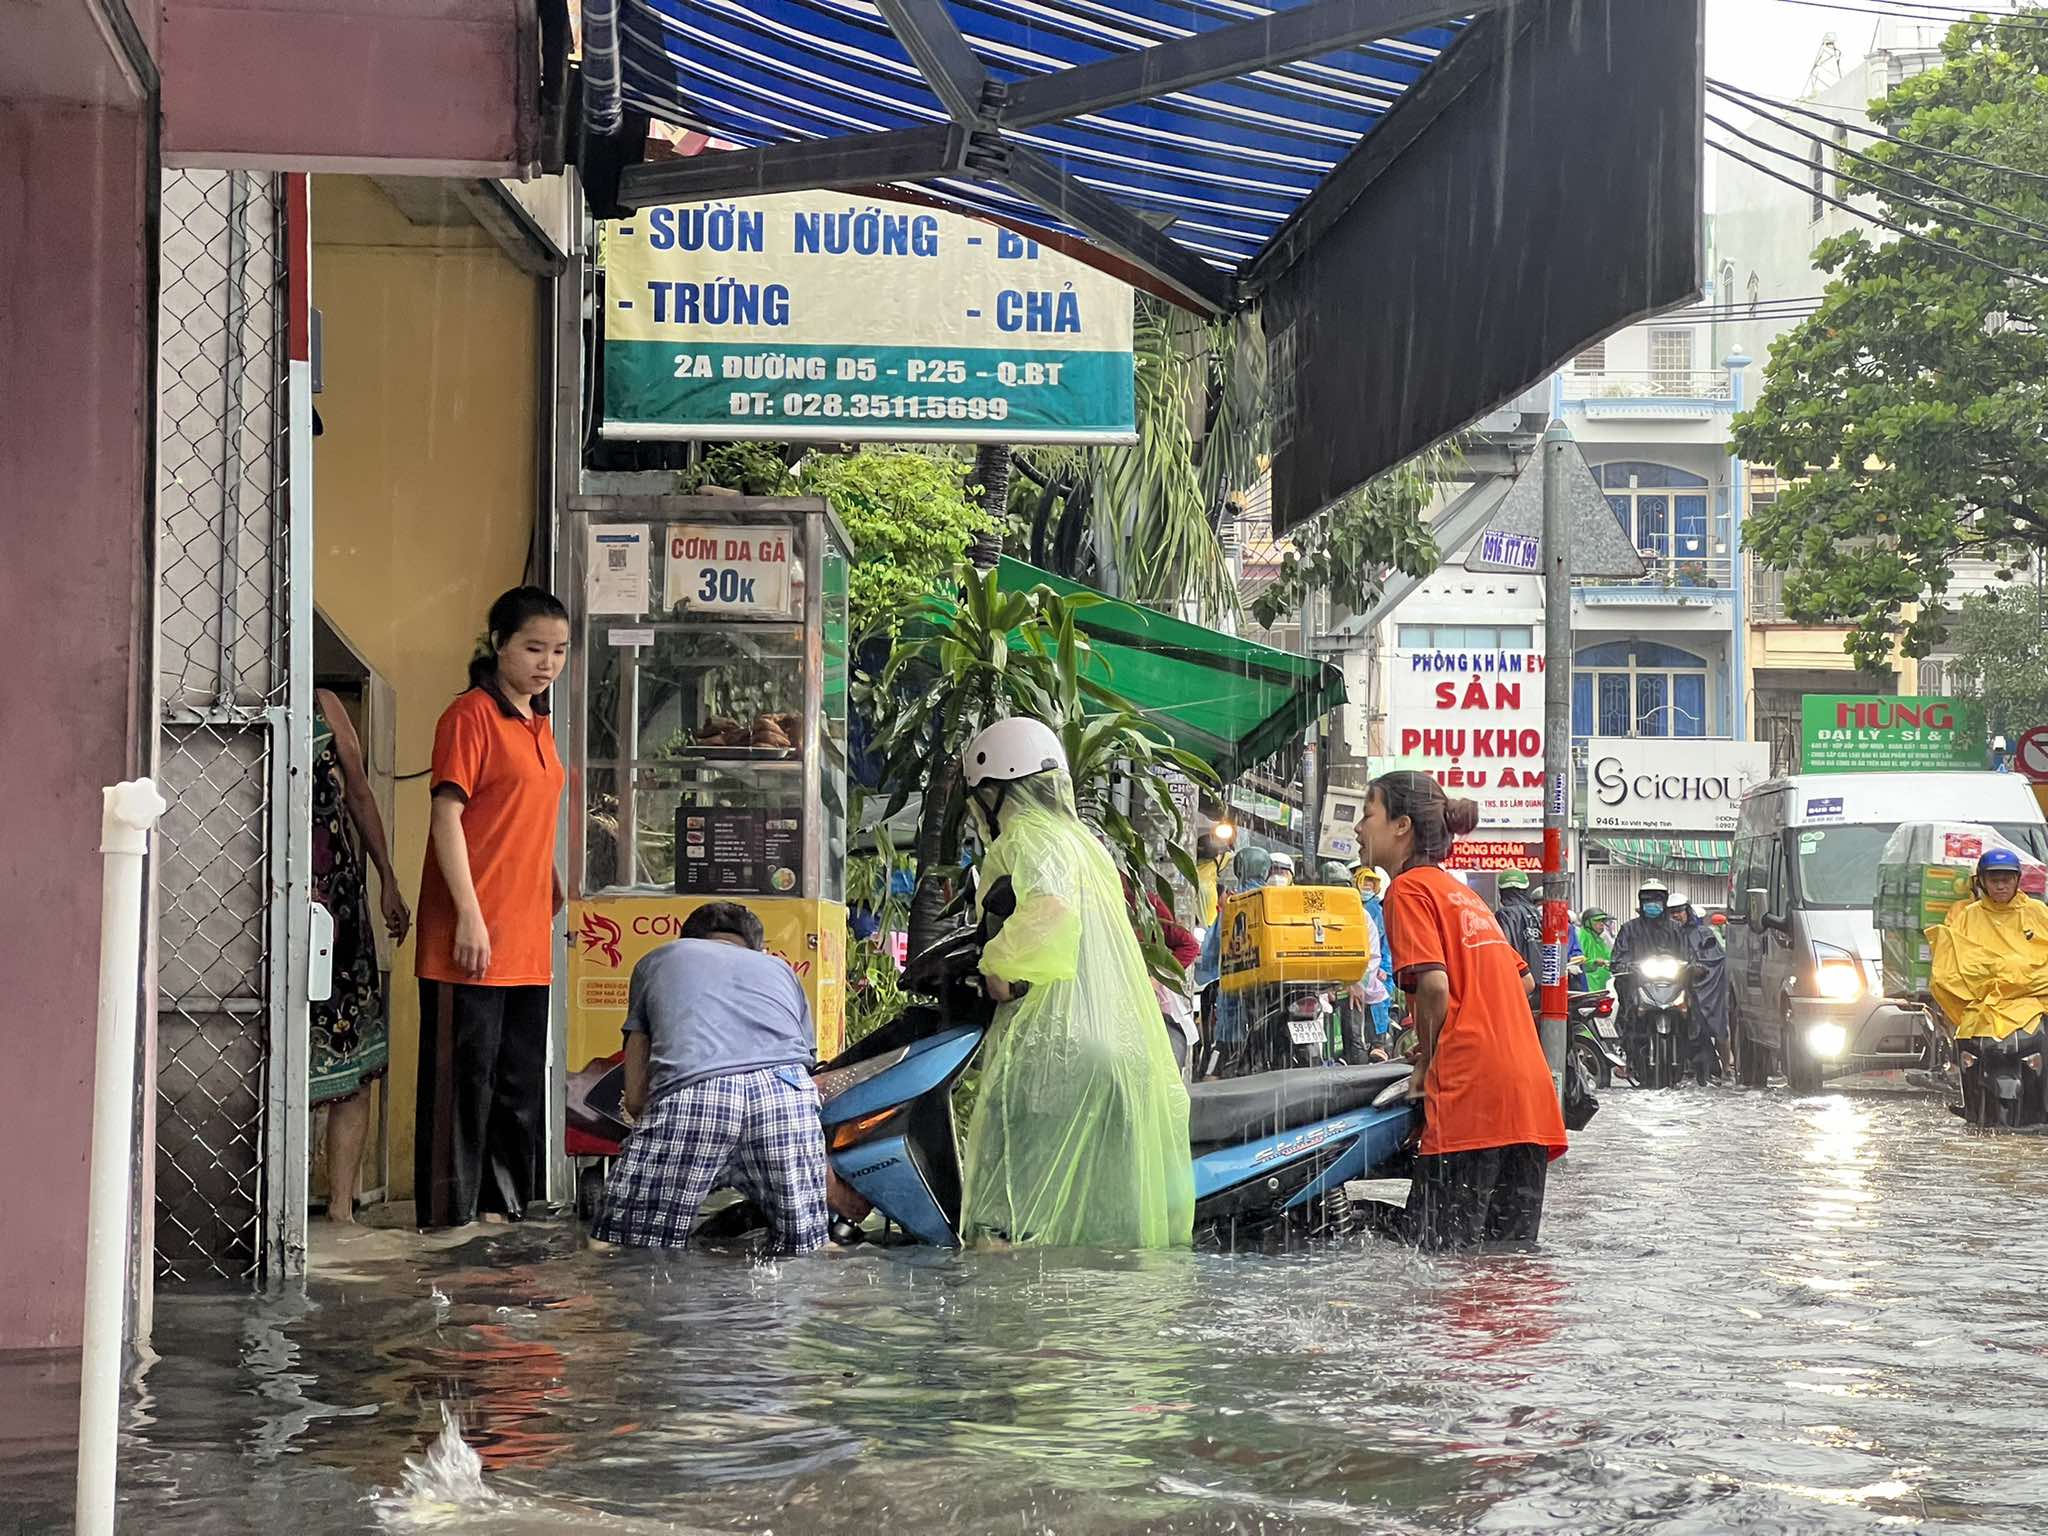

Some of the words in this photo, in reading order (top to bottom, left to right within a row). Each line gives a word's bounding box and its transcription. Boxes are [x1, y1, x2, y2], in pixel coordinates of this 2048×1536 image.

[648, 205, 764, 252] SƯỜN
[793, 207, 938, 257] NƯỚNG
[648, 277, 789, 326] TRỨNG
[996, 282, 1081, 333] CHẢ
[674, 355, 713, 379] 2A
[721, 352, 825, 382] ĐƯỜNG
[836, 358, 877, 382] D5
[907, 360, 966, 385] P.25
[997, 361, 1063, 387] Q.BT
[729, 391, 774, 416] ĐT:
[783, 392, 1008, 421] 028.3511.5699
[671, 535, 718, 561] CƠM
[725, 539, 752, 562] DA
[758, 536, 786, 562] GÀ
[1482, 536, 1537, 568] 0916.177.199
[1412, 650, 1468, 673] PHÒNG
[1472, 650, 1522, 673] KHÁM
[1435, 674, 1522, 710] SẢN
[1836, 698, 1954, 730] HÙNG
[1402, 728, 1466, 764] PHỤ
[1473, 728, 1546, 758] KHO
[850, 1156, 902, 1178] HONDA
